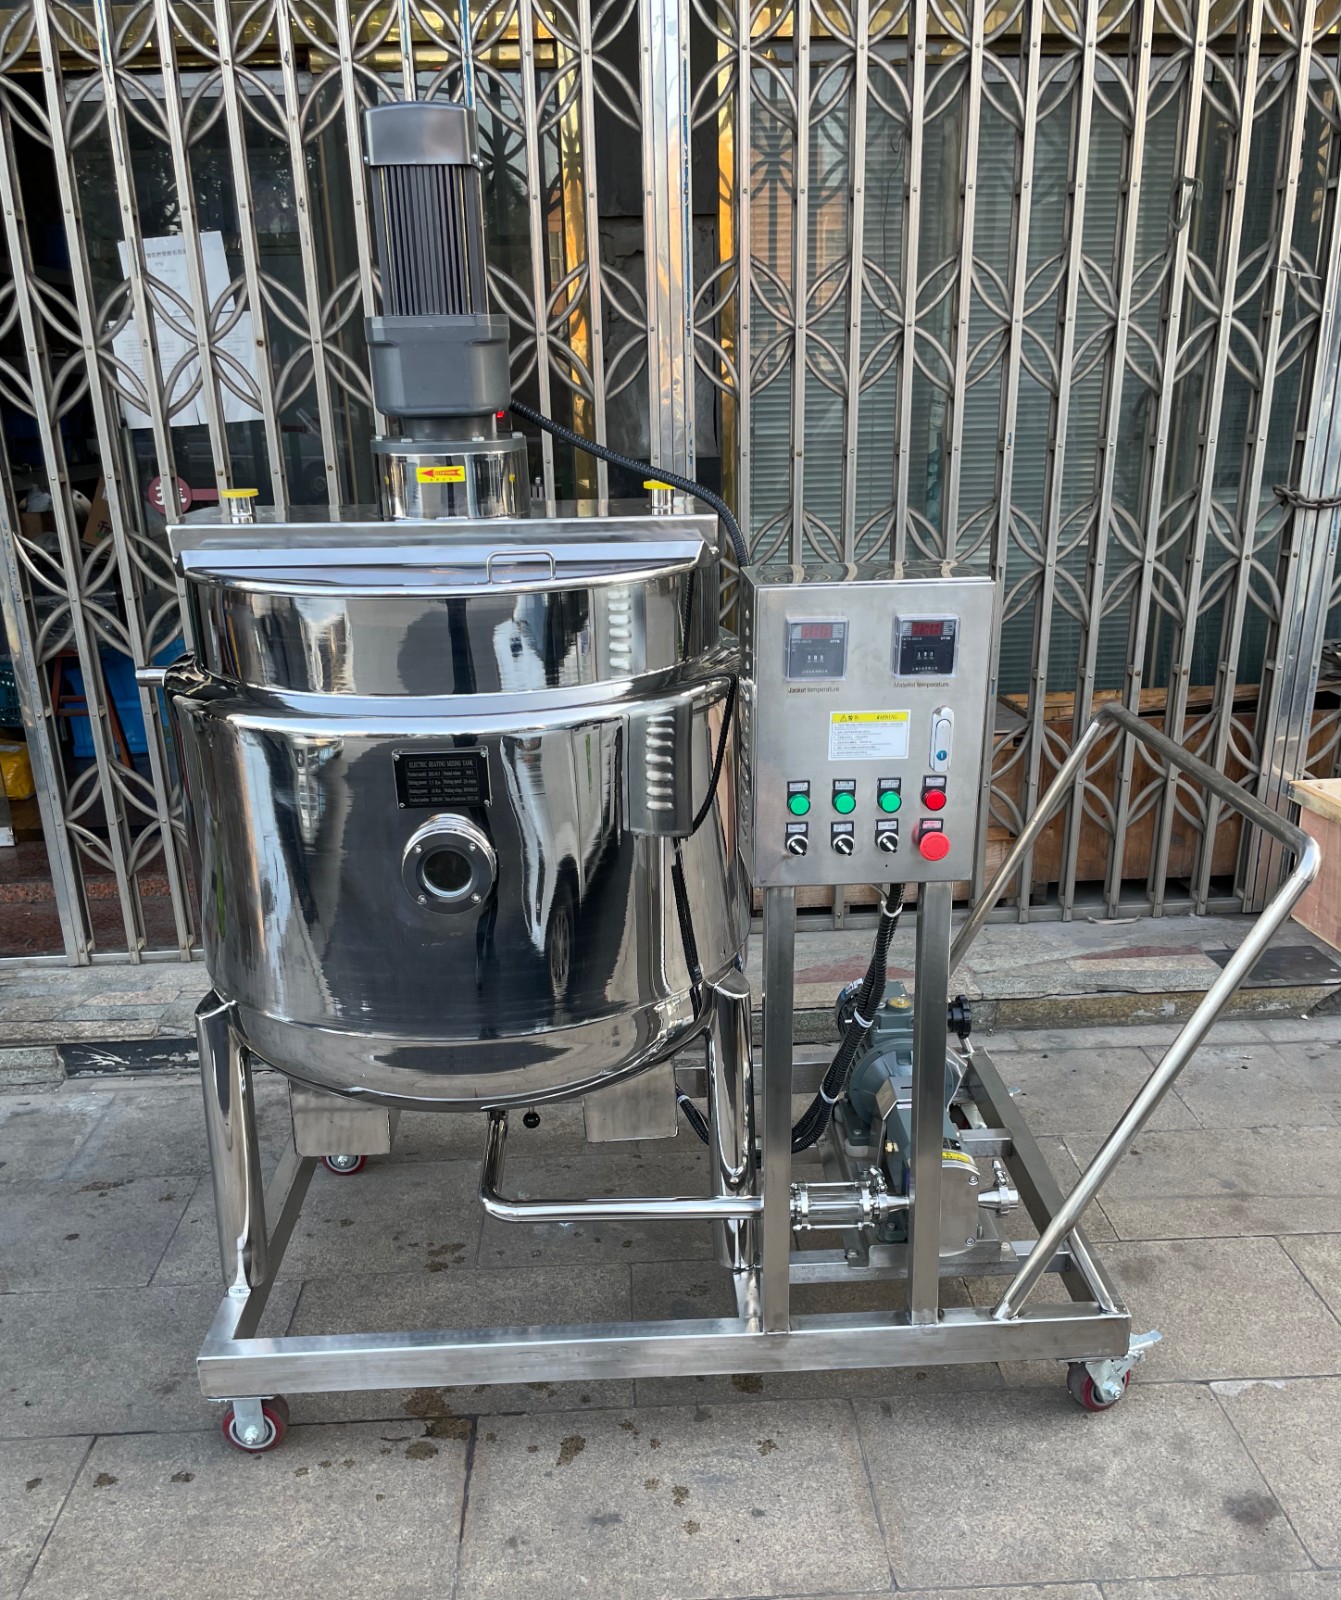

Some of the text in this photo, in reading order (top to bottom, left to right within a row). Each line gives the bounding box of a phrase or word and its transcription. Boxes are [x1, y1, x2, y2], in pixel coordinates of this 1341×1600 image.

[408, 761, 428, 769] ELECTRIC
[428, 760, 446, 768] HEATING
[462, 759, 474, 767] TANK
